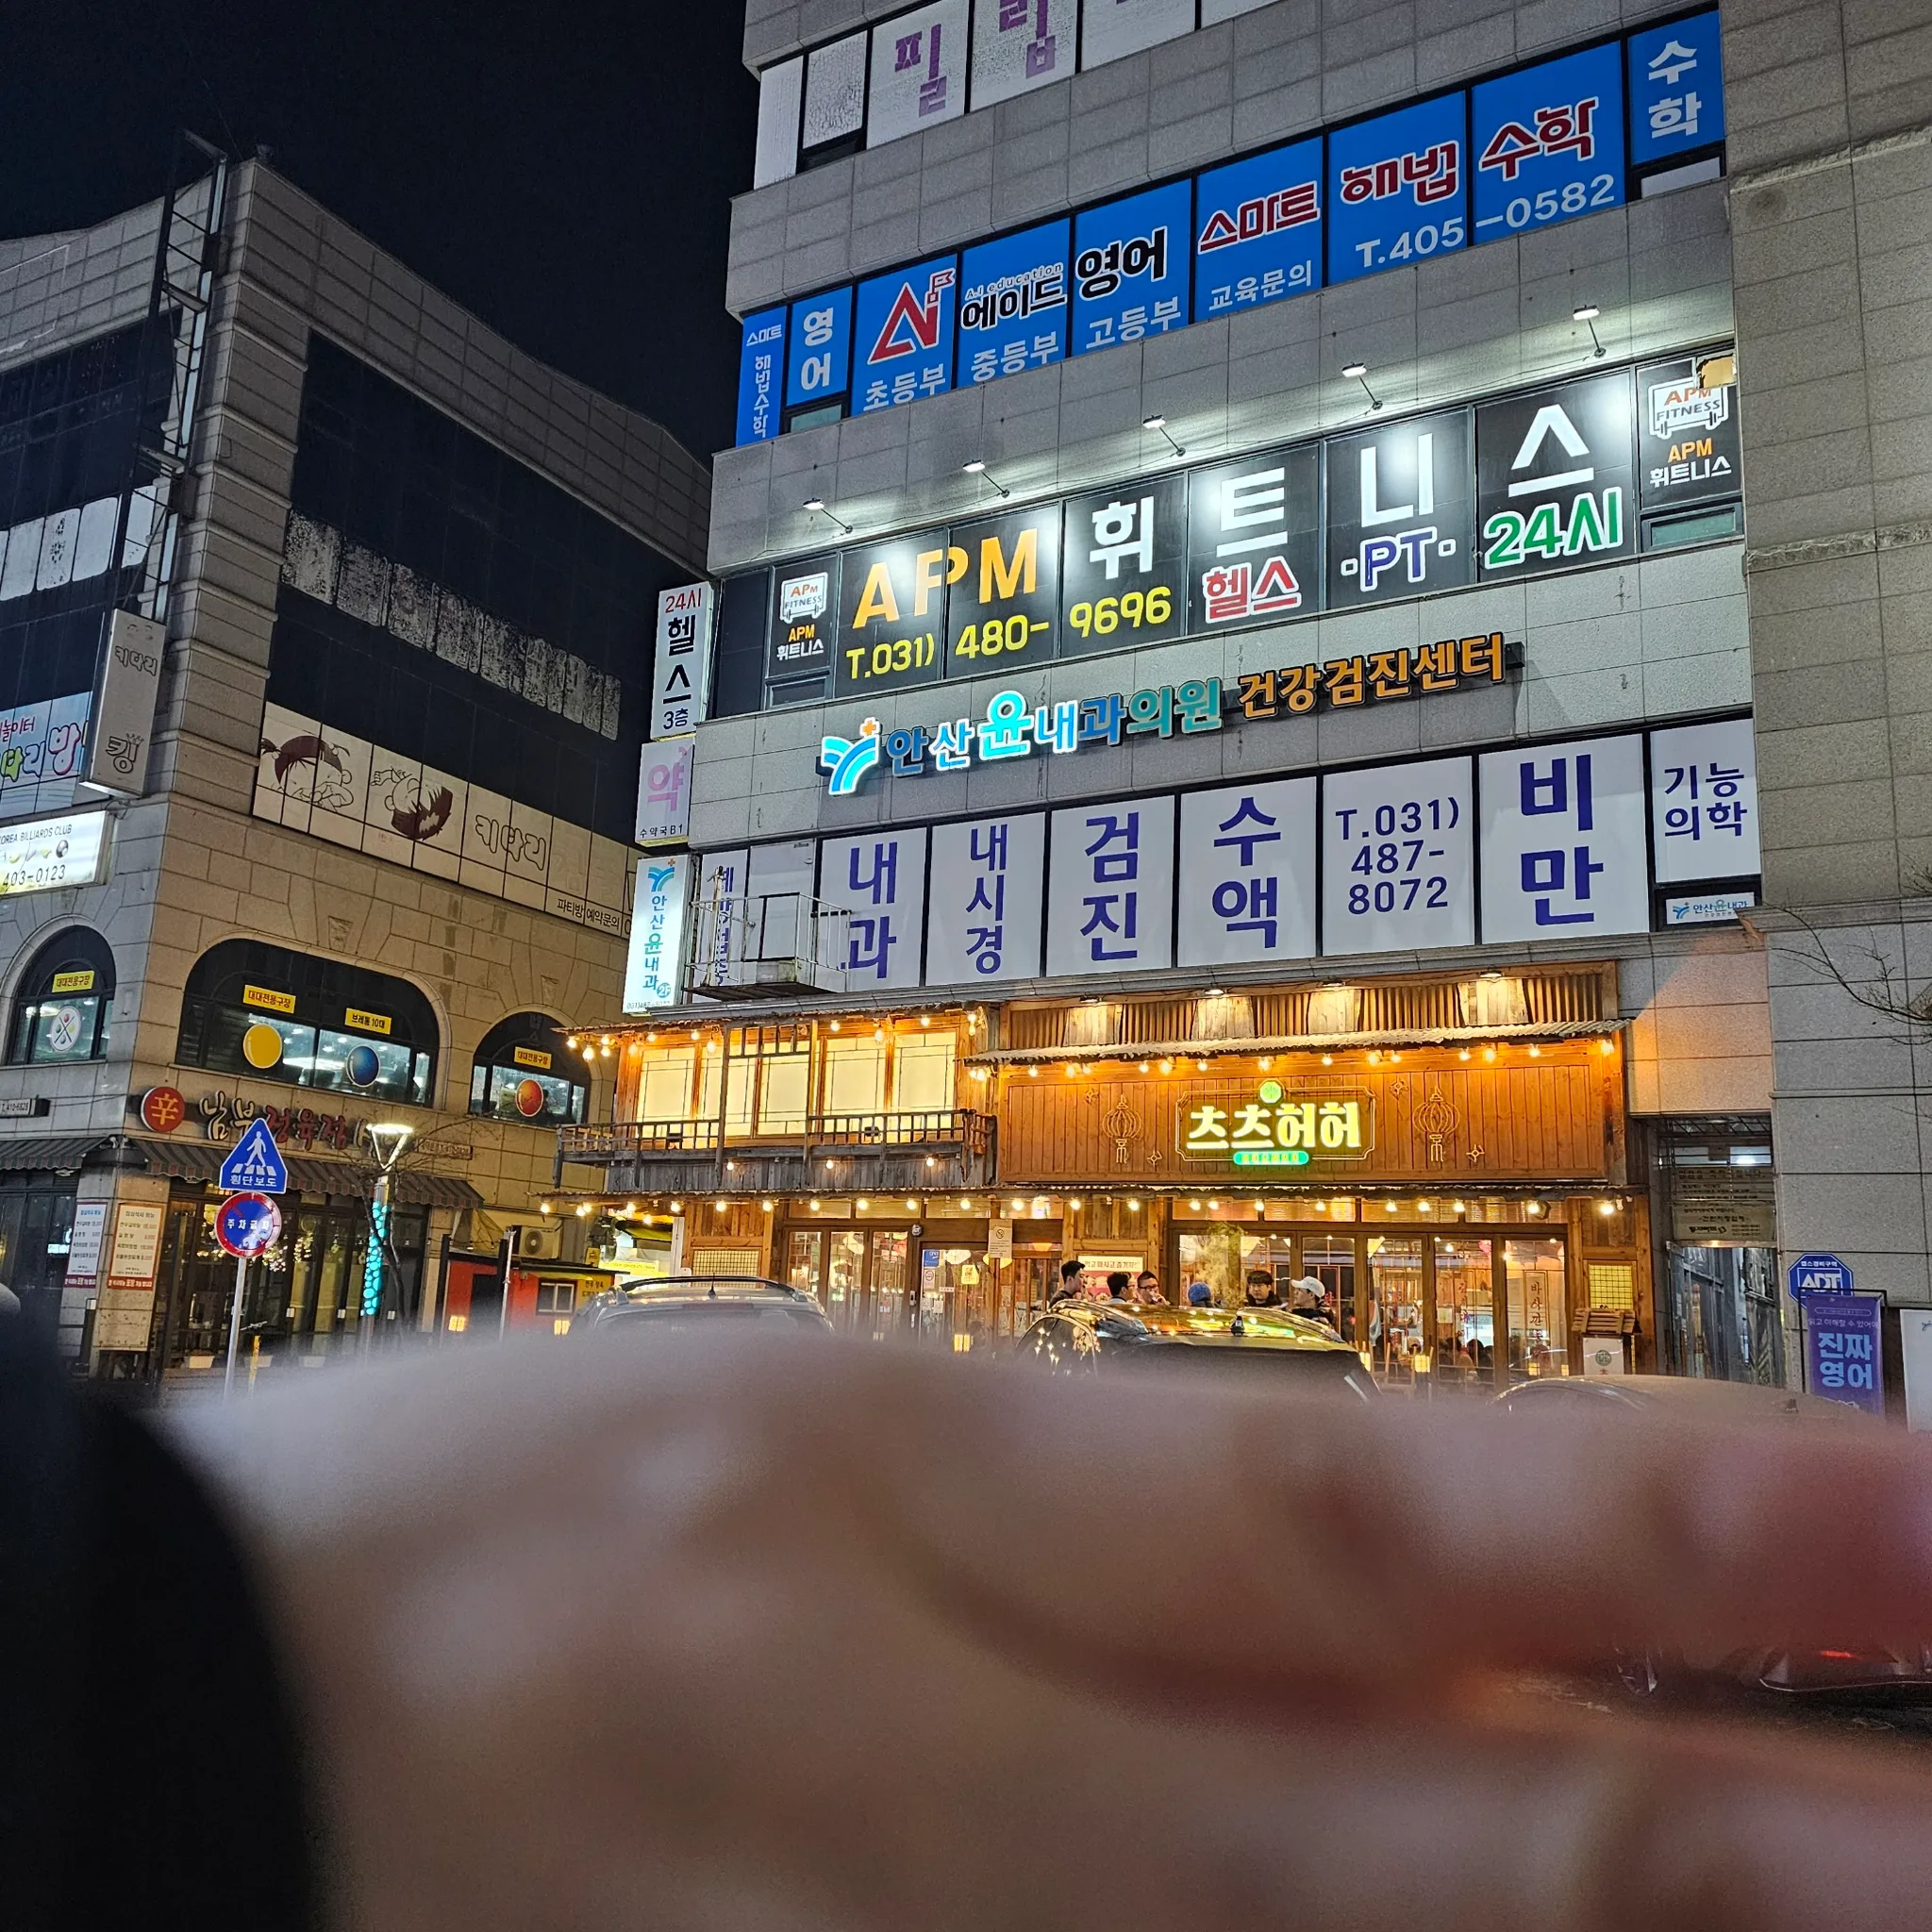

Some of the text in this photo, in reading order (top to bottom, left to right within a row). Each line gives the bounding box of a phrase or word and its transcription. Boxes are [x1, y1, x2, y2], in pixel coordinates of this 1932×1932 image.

[1647, 40, 1702, 141] 수학
[1199, 96, 1600, 255] 스마트 해법 수학
[960, 225, 1168, 330] 에이드 영어
[988, 262, 1063, 293] education
[1208, 260, 1313, 311] 교육문의
[746, 324, 782, 346] 스마트
[1086, 295, 1181, 350] 고등부
[801, 308, 834, 391] 영어
[971, 331, 1058, 383] 중등부
[863, 363, 946, 413] 초등부
[1656, 399, 1721, 422] FITNESS
[1649, 456, 1732, 489] 휘트니스
[1667, 438, 1713, 463] APM
[852, 526, 1038, 630] APM
[1203, 556, 1304, 624] 헬스
[1483, 486, 1623, 570] 24시
[664, 588, 702, 613] 24시
[784, 594, 823, 610] FITNESS
[790, 584, 819, 598] APM
[776, 639, 824, 661] 휘트니스
[788, 624, 815, 642] APM
[846, 632, 935, 679] T.031)
[1069, 586, 1173, 639] 9696
[114, 645, 158, 677] 키다리
[662, 614, 695, 705] 헬스
[663, 708, 689, 730] 3층
[885, 632, 1507, 777] 안산윤내과의원 건강검진센터
[1664, 762, 1744, 800] 기능
[55, 824, 73, 836] CLUB
[1335, 797, 1460, 842] T.031)
[1520, 754, 1604, 926] 비만
[1665, 801, 1748, 841] 의학
[475, 815, 546, 872] 키다리
[1080, 812, 1140, 962] 검진
[1212, 796, 1282, 950] 수액
[1348, 876, 1448, 915] 8072
[840, 841, 898, 980] 내과
[965, 824, 1008, 975] 내시경
[642, 895, 667, 991] 안산윤내과
[1186, 1101, 1362, 1150] 츠츠허허
[229, 1174, 277, 1189] 횡단보도
[1800, 1273, 1842, 1293] ADT
[1818, 1332, 1873, 1361] 진짜
[1820, 1361, 1874, 1390] 영어
